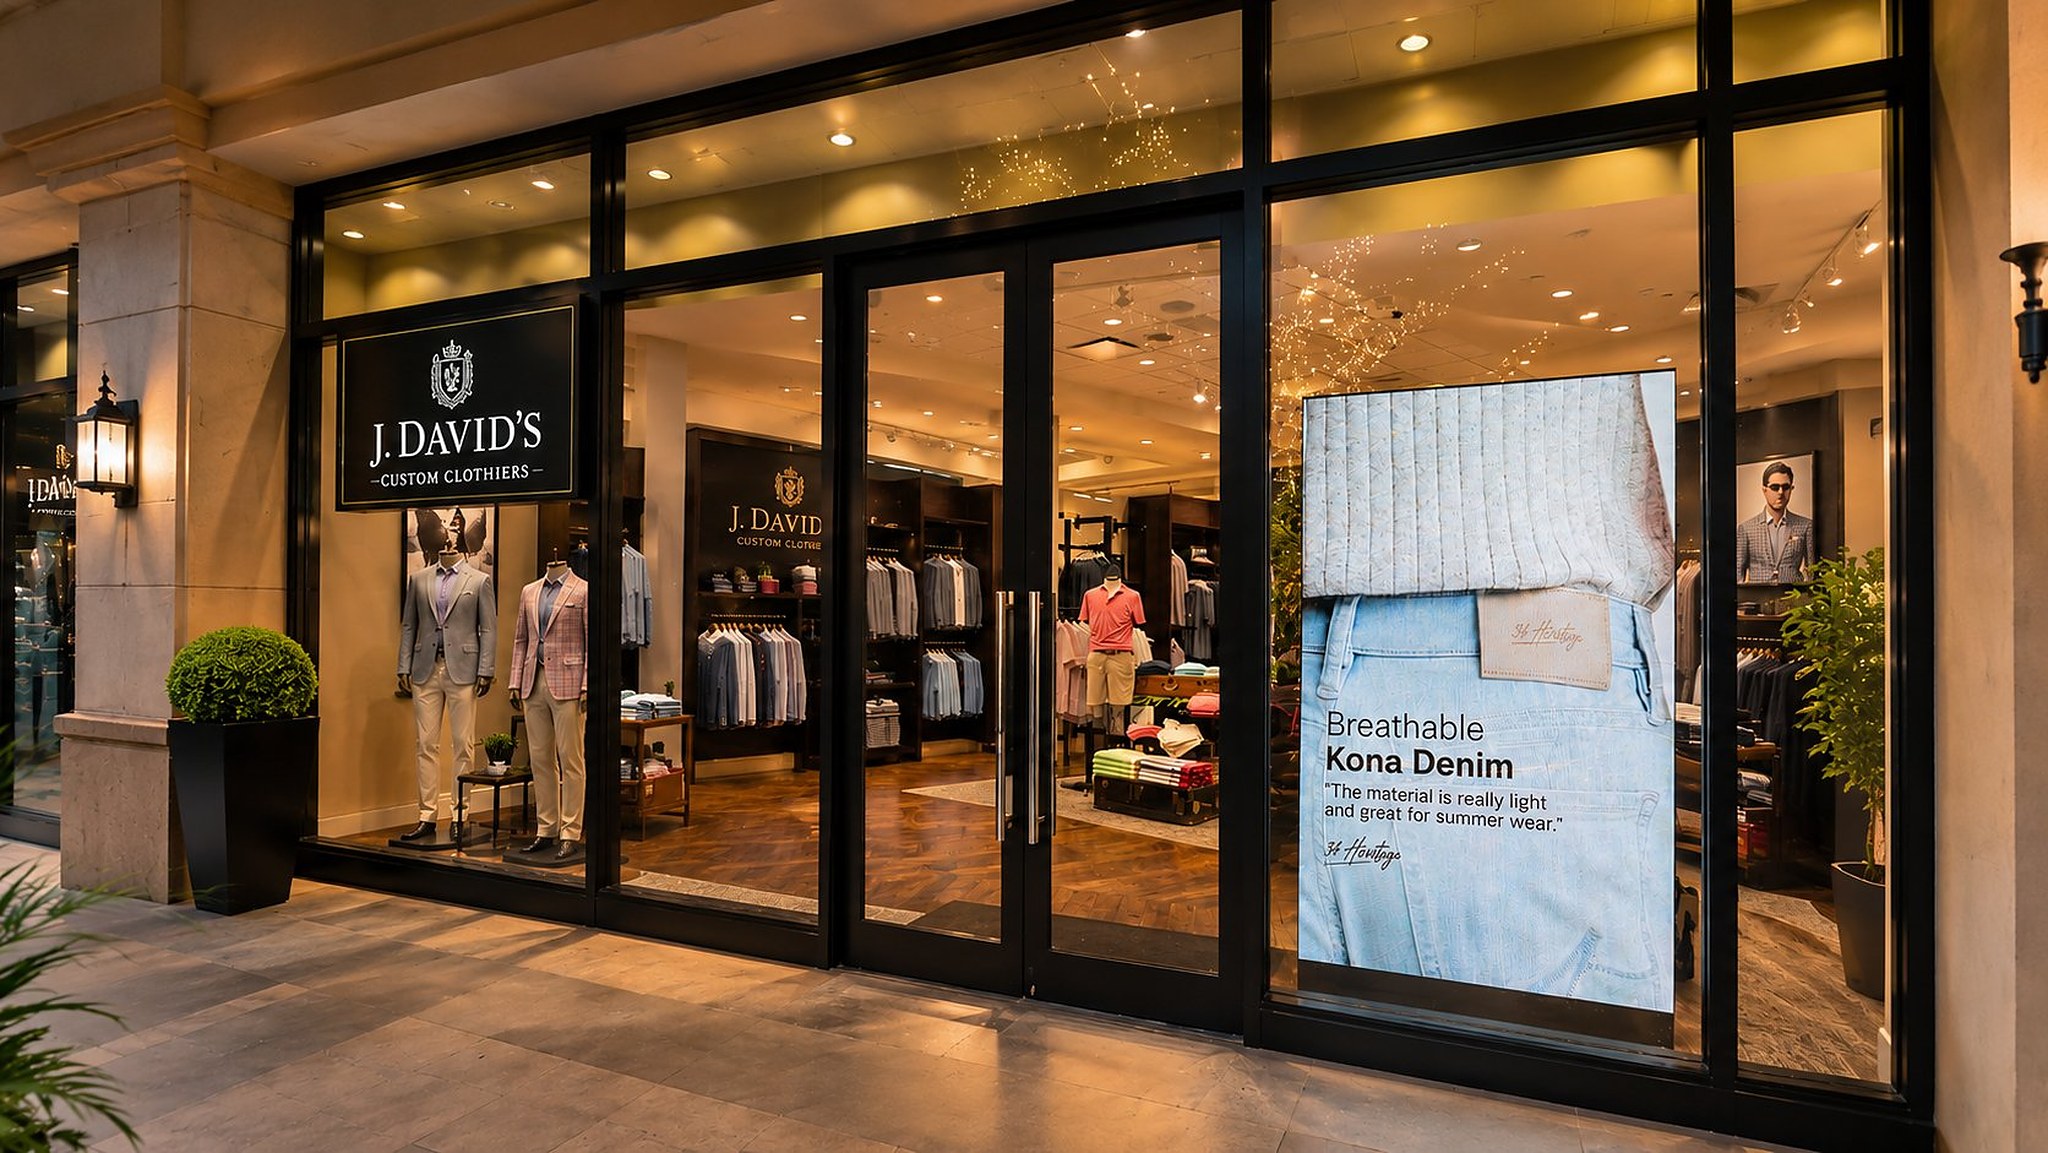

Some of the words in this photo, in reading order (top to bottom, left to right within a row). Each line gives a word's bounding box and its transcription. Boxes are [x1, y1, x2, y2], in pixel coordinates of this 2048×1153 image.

[369, 423, 391, 468] J.
[398, 410, 542, 458] DAVID'S
[380, 471, 439, 487] CUSTOM
[443, 464, 530, 484] CLOTHIERS
[728, 505, 744, 533] J.
[750, 507, 822, 535] DAVID
[736, 536, 781, 547] CUSTOM
[1327, 710, 1484, 742] Breathable
[1326, 745, 1404, 774] Kona
[1413, 748, 1514, 780] Denim
[1324, 782, 1362, 799] "The
[1366, 786, 1433, 804] material
[1438, 789, 1452, 805] is
[1457, 791, 1504, 812] really
[1509, 793, 1548, 814] light
[1324, 803, 1355, 818] and
[1359, 806, 1402, 823] great
[1407, 807, 1431, 822] for
[1435, 811, 1504, 828] summer
[1509, 816, 1564, 833] wear."
